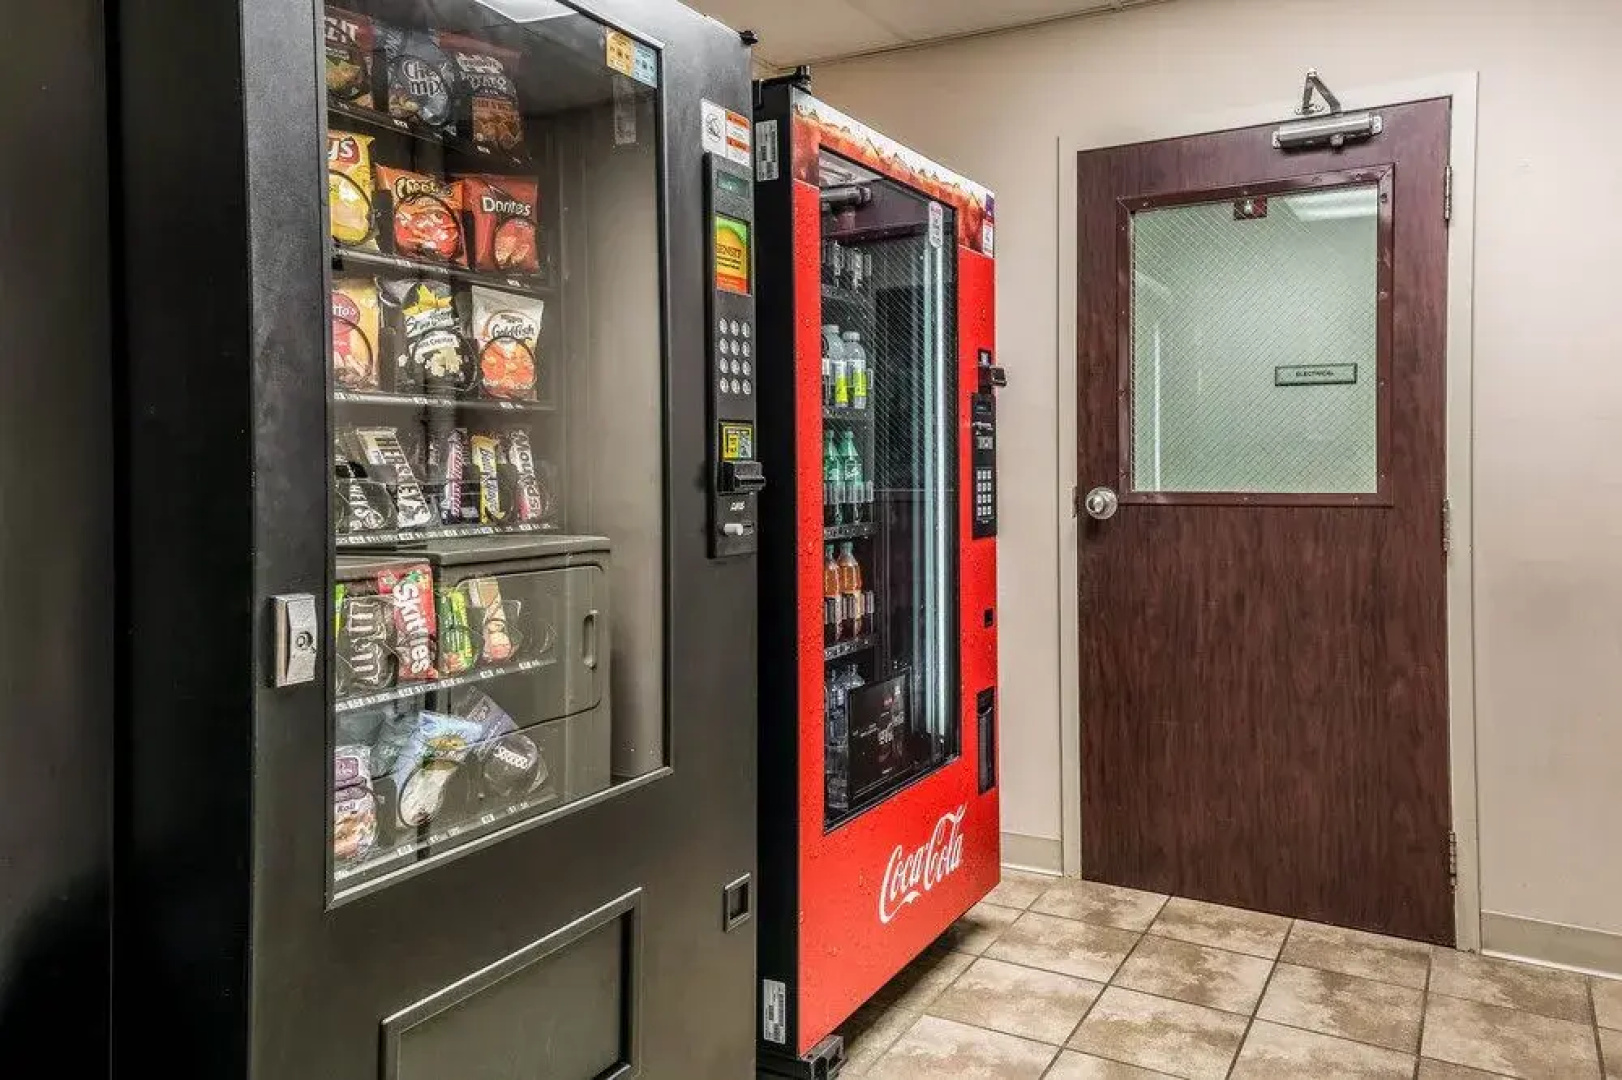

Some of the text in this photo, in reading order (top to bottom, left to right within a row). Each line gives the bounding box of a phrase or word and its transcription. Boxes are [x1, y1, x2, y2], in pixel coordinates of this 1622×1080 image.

[482, 196, 532, 217] Doritos
[491, 323, 535, 338] Goldfish
[393, 583, 430, 674] Skittles
